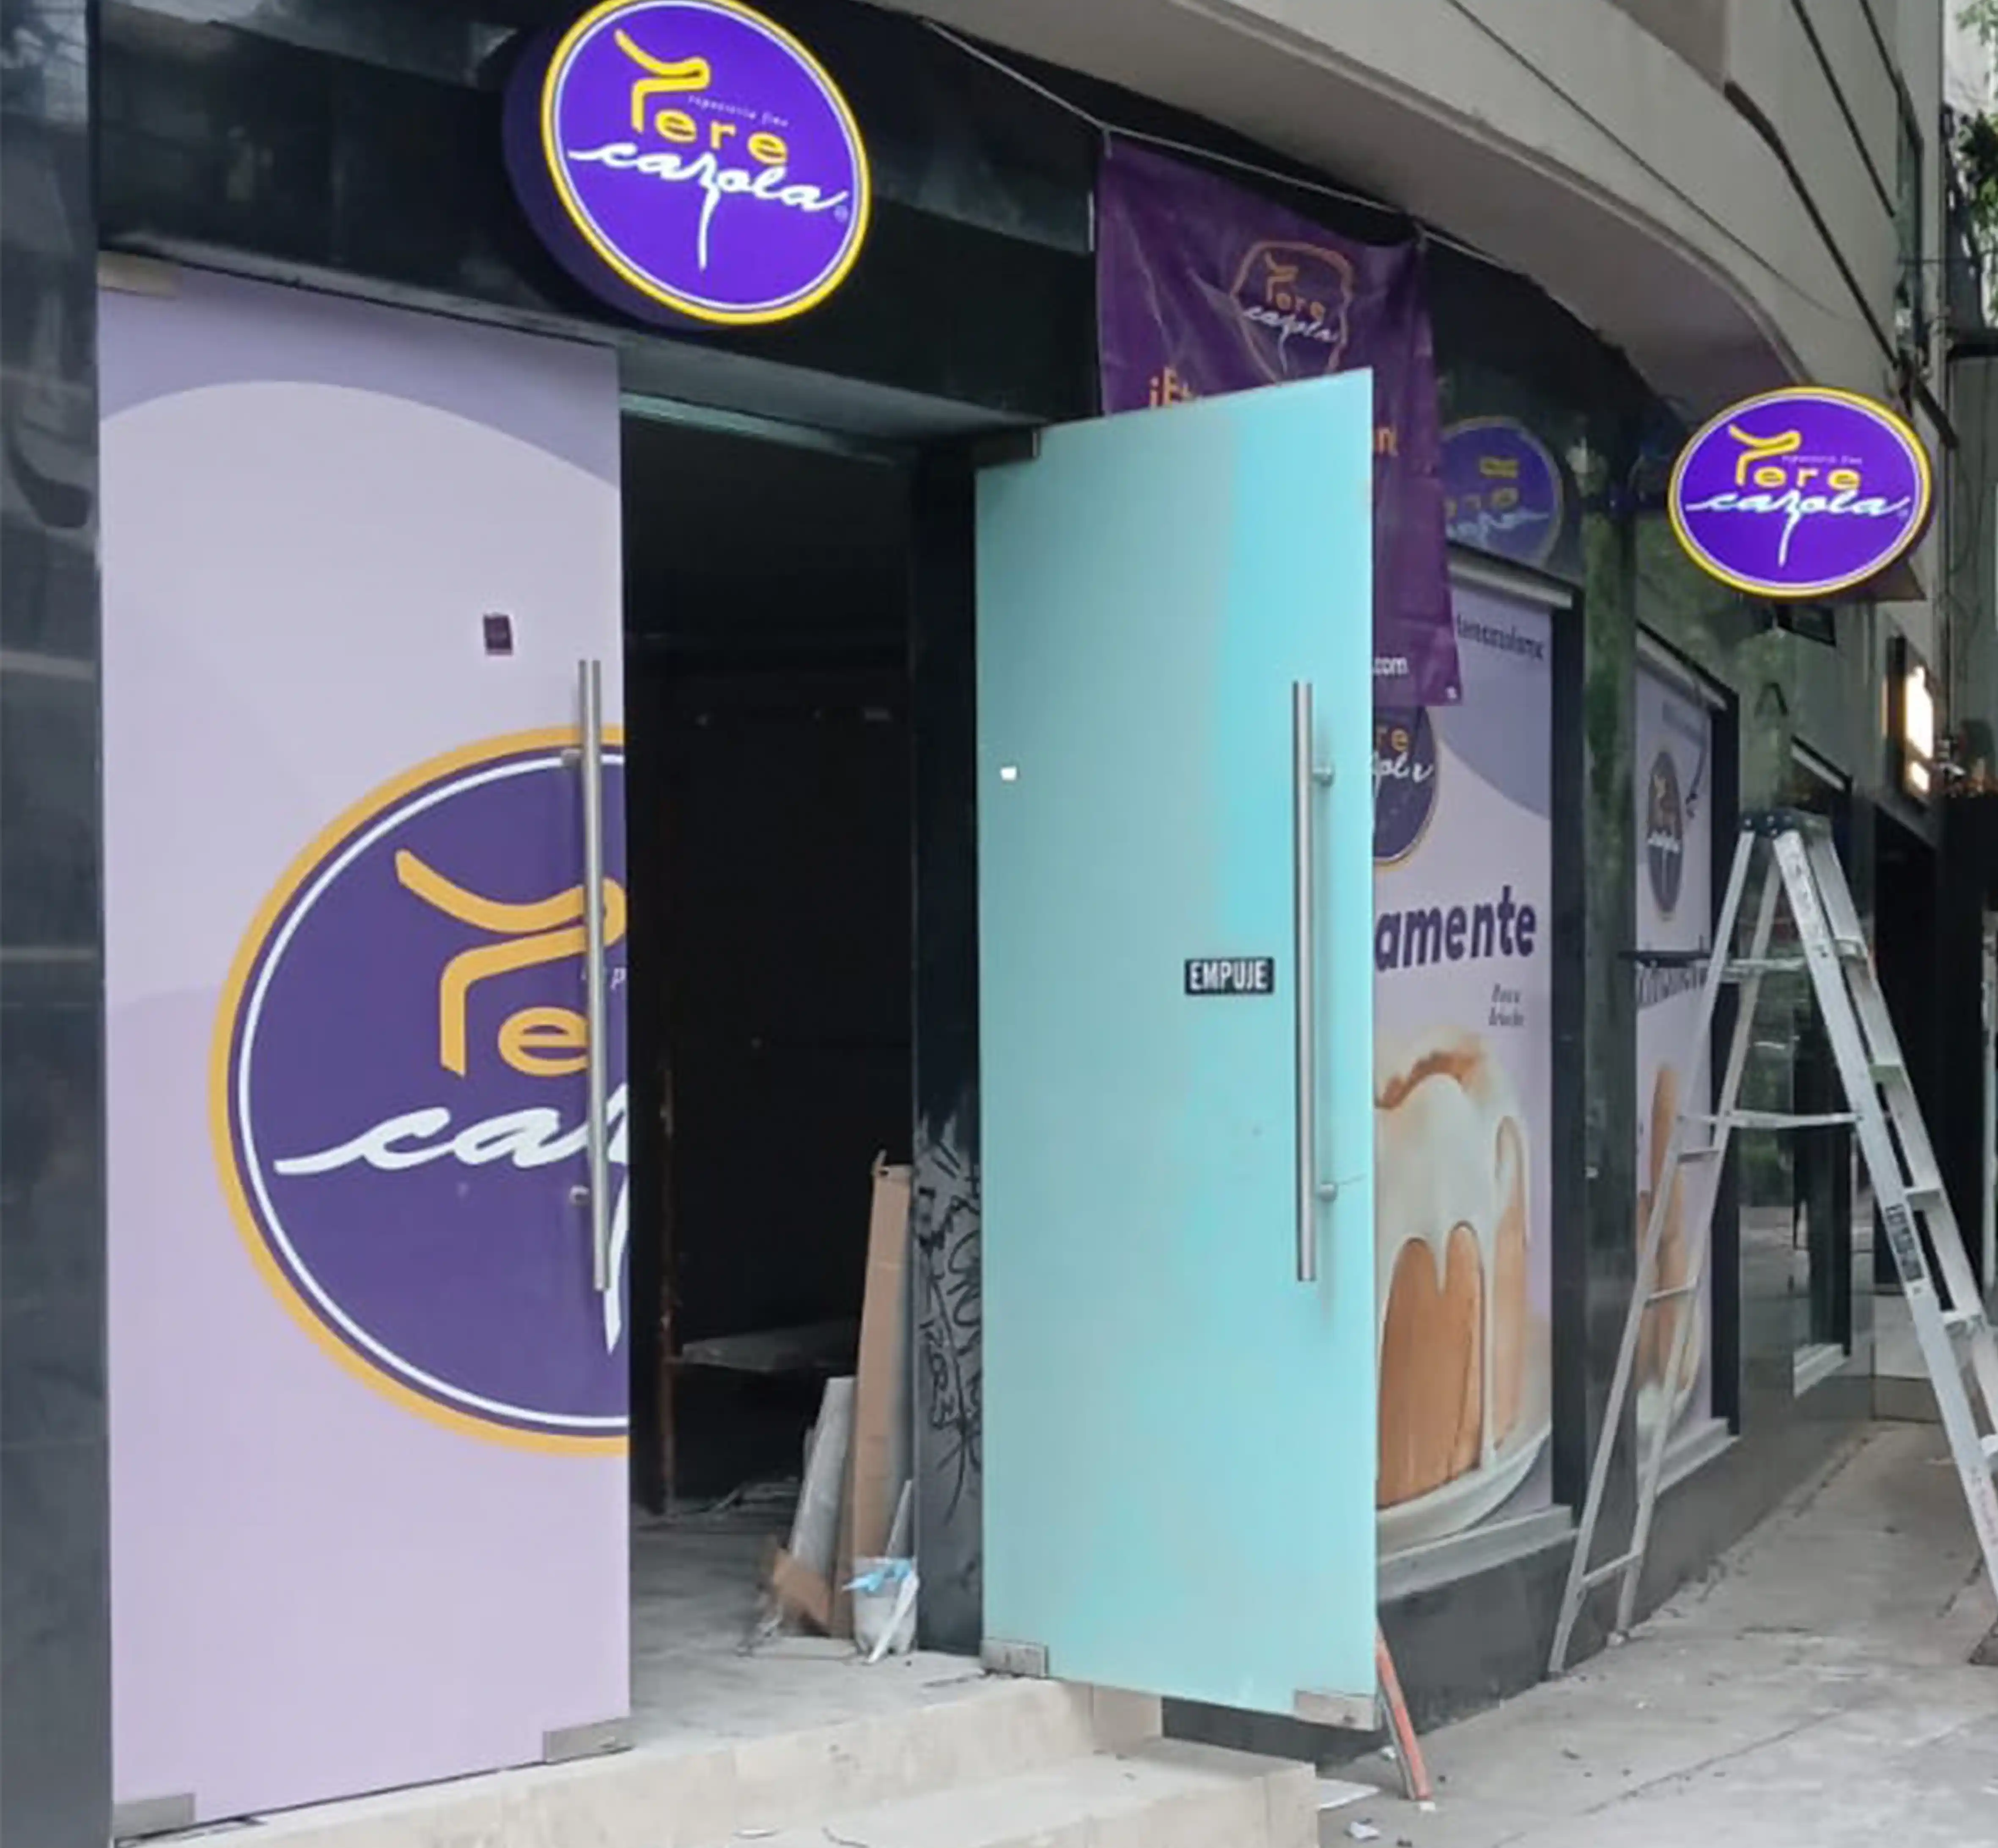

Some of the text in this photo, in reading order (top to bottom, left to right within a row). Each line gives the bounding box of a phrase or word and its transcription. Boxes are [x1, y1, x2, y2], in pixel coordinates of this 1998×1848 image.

[614, 28, 788, 165] Tere
[567, 142, 848, 271] carola
[1728, 424, 1861, 491] Tere
[1685, 489, 1911, 568] carola
[1375, 885, 1536, 973] amente
[1190, 960, 1268, 990] EMPUJE
